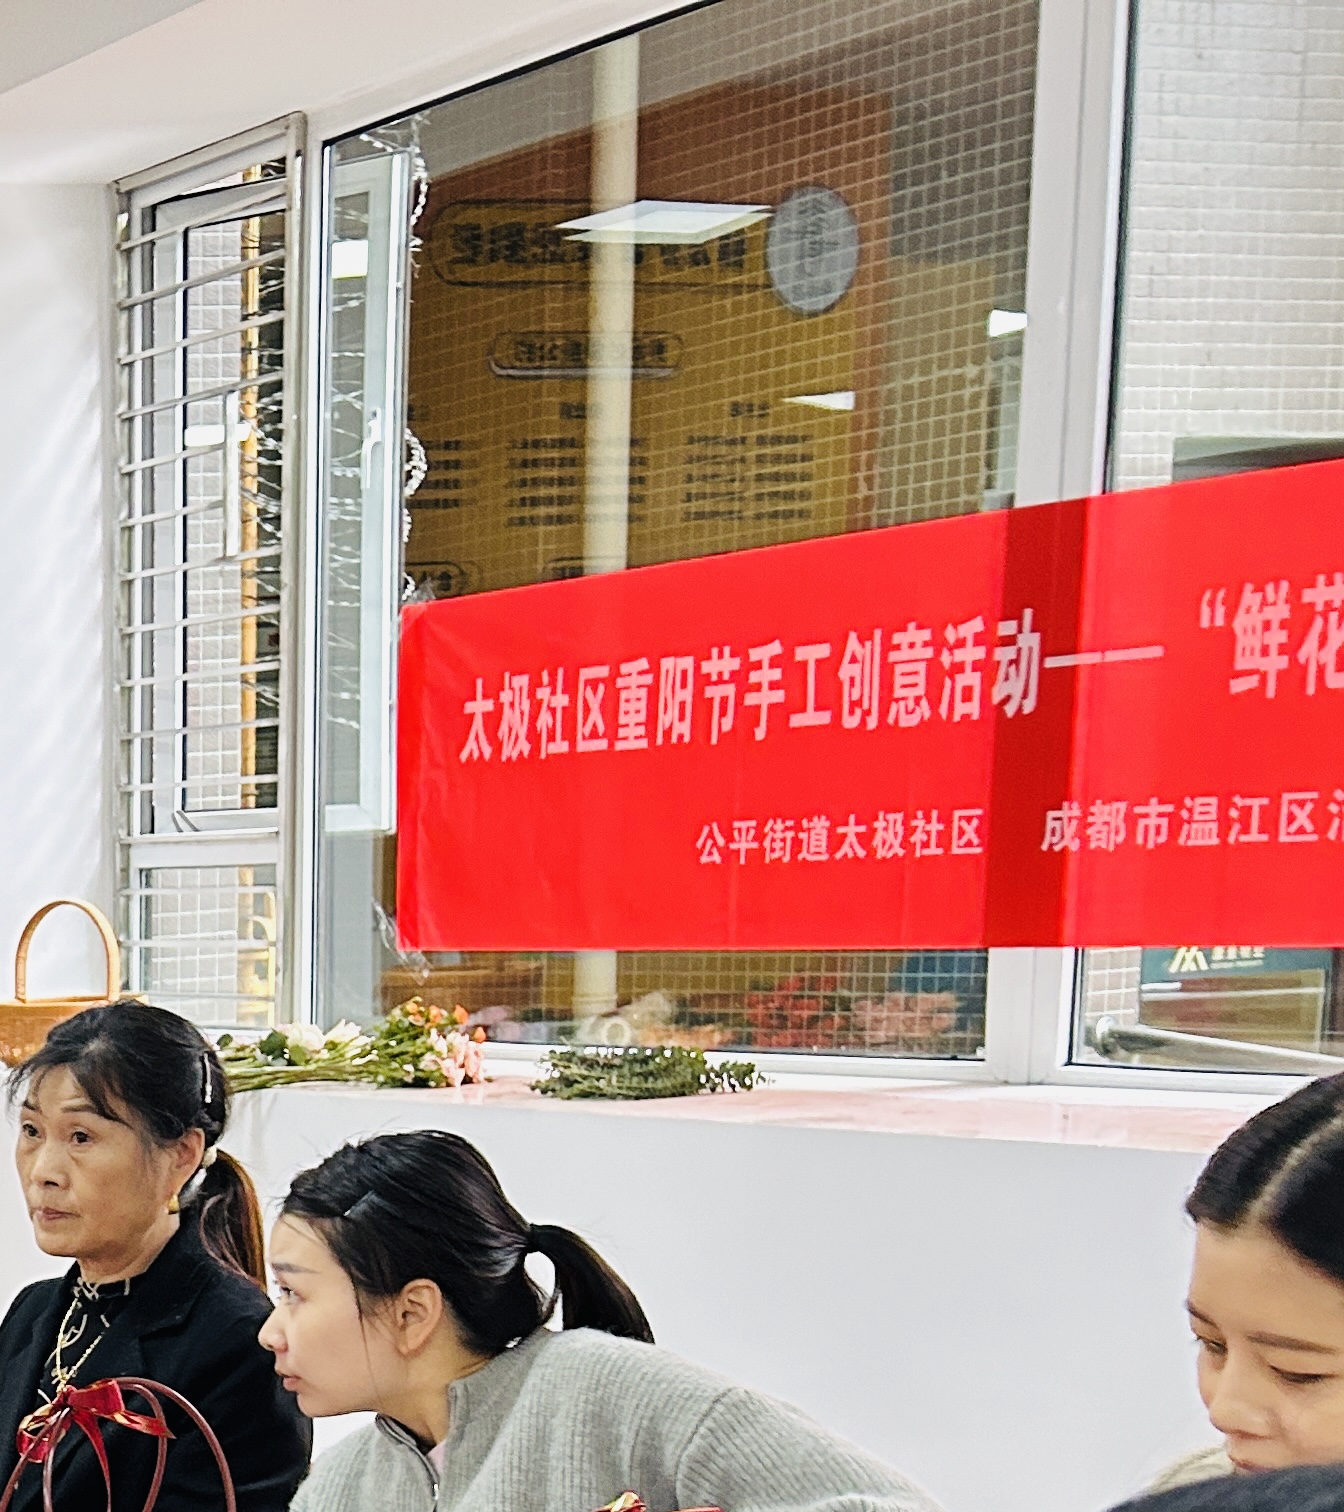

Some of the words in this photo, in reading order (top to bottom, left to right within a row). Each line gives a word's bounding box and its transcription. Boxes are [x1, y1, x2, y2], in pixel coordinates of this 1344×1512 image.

[696, 809, 982, 864] 公平街道太极社区
